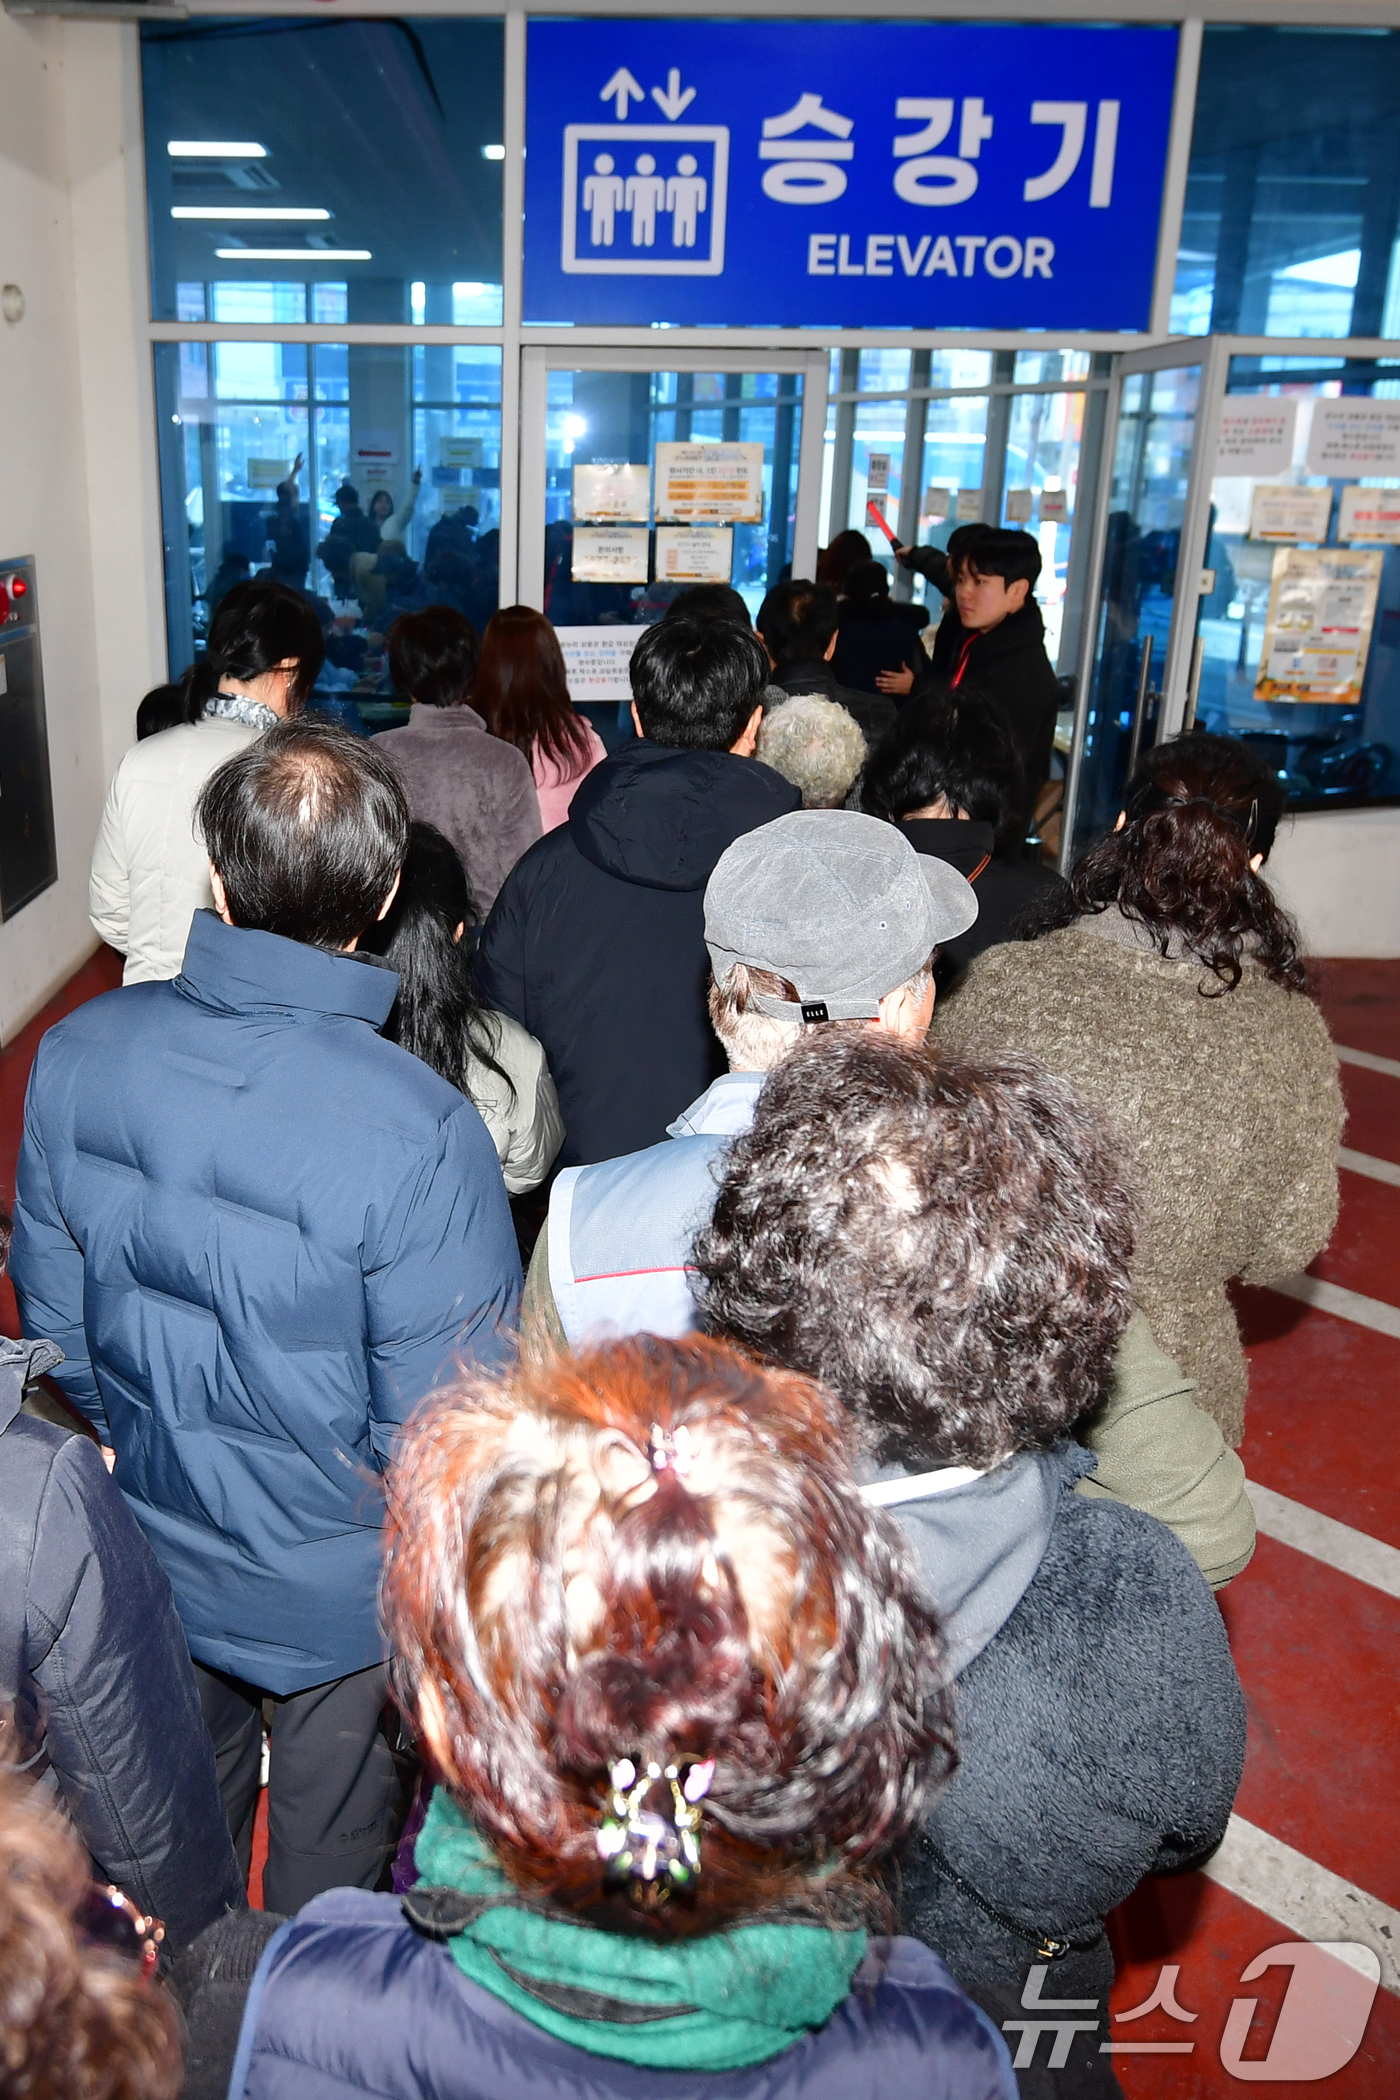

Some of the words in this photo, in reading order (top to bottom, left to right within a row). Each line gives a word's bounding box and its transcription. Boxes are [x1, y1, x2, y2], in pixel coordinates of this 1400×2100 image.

[758, 93, 1120, 208] 승강기
[807, 234, 1055, 278] ELEVATOR
[806, 1009, 824, 1017] ELLE
